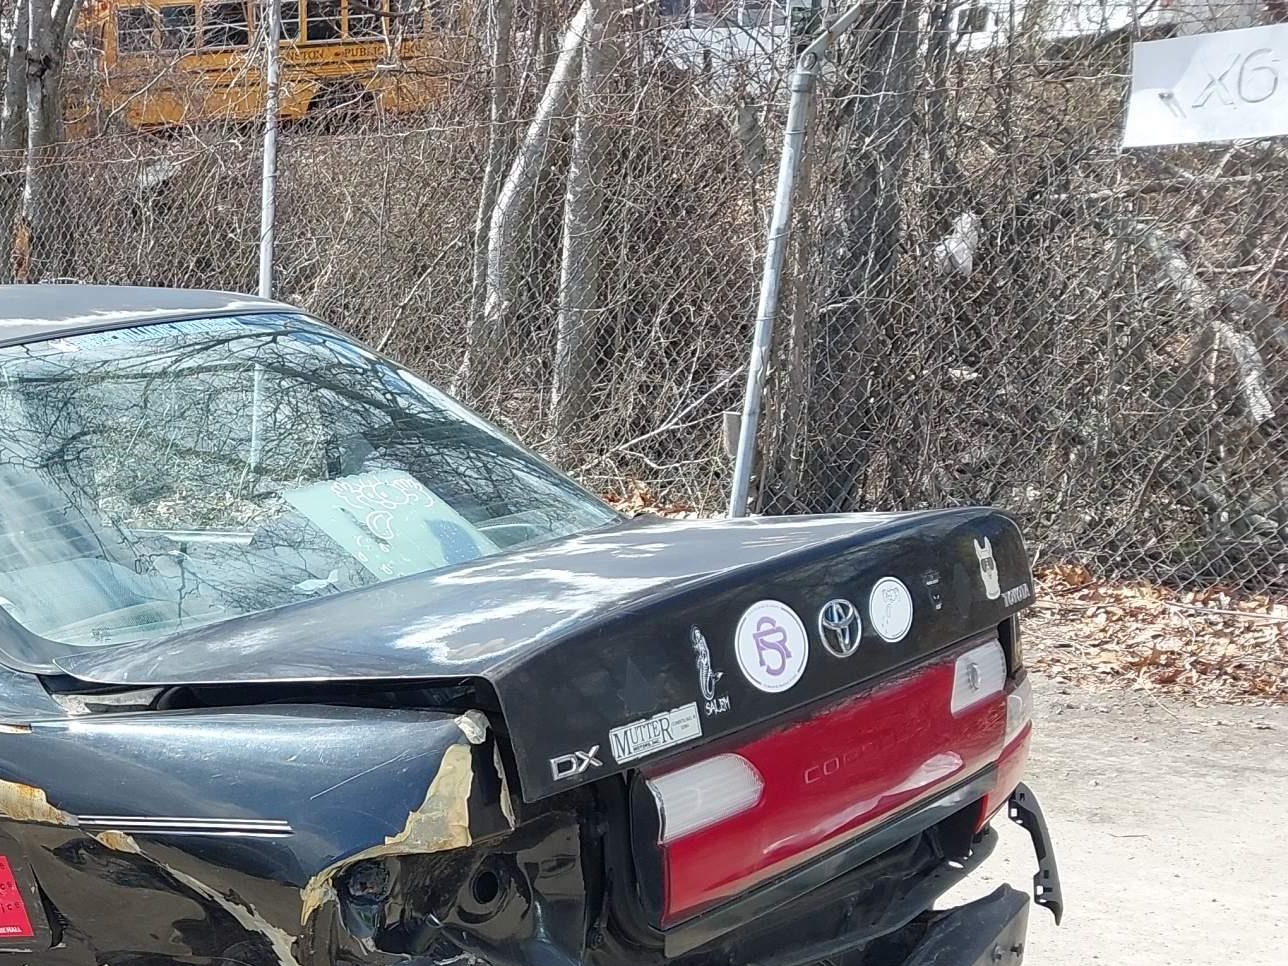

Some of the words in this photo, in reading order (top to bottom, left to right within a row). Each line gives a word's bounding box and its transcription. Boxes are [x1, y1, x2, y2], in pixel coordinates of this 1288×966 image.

[1000, 583, 1031, 608] TOYOTA
[705, 695, 731, 716] SALEM
[613, 717, 674, 759] MUTTER
[549, 745, 603, 782] DX
